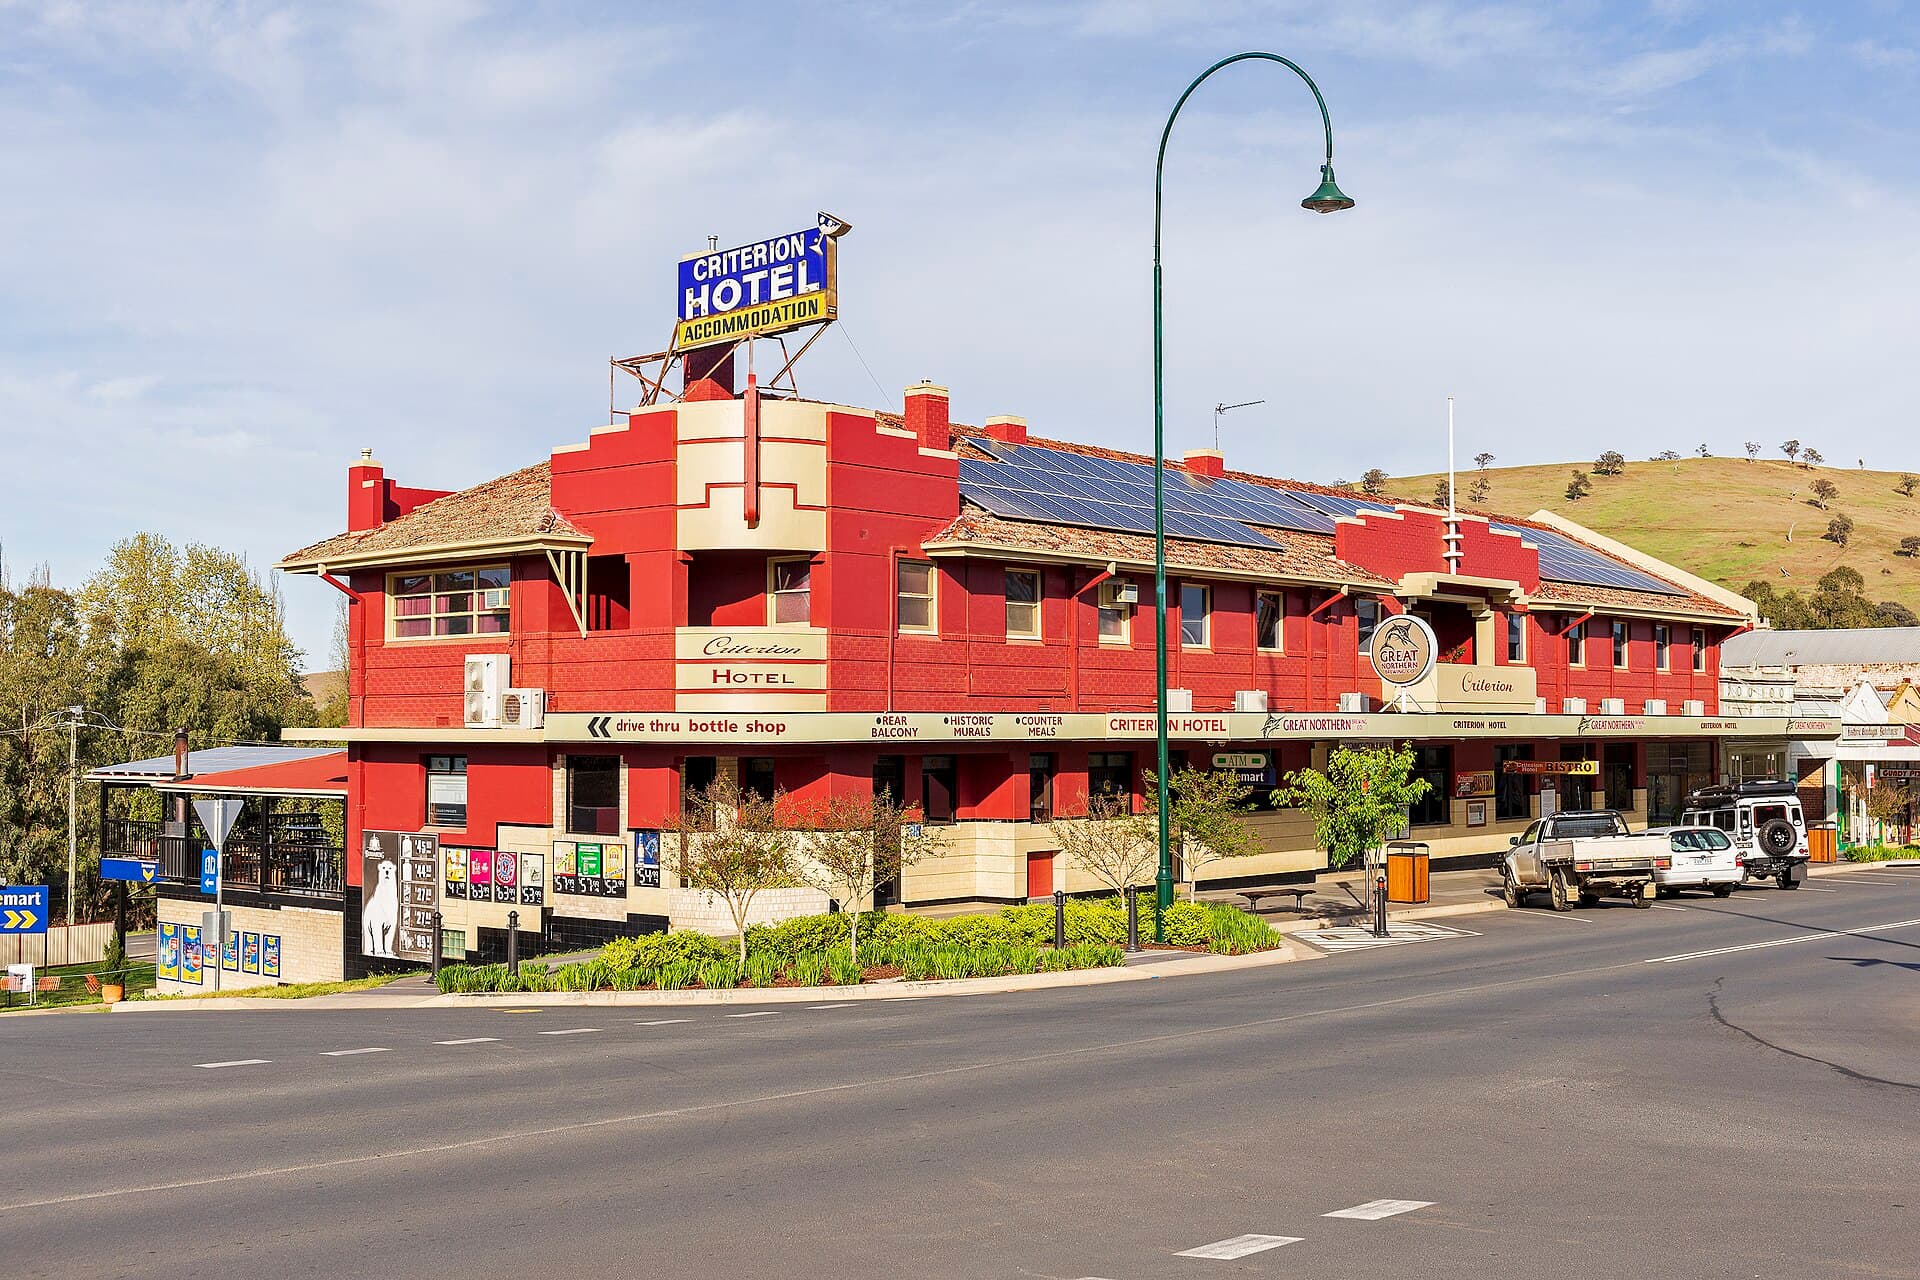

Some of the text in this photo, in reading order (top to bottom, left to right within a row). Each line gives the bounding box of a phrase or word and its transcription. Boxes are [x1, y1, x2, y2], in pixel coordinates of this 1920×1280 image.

[693, 233, 805, 281] CRITERION
[685, 260, 820, 320] HOTEL
[684, 298, 818, 343] ACCOMMODATION
[703, 636, 802, 656] Criterion
[1380, 650, 1419, 662] GREAT
[1381, 662, 1418, 670] NORTHERN
[1462, 671, 1514, 693] Criterion
[882, 716, 908, 726] REAR
[950, 716, 994, 726] HISTORIC
[1021, 716, 1063, 726] COUNTER
[1110, 719, 1227, 731] CRITERIN HOTEL
[1283, 719, 1351, 731] GREAT NORTHERN
[1453, 720, 1507, 729] CRITERION HOTEL
[1591, 720, 1607, 729] GREAT
[1607, 720, 1635, 729] NORTHERN
[616, 719, 786, 736] drive thru bottle shop
[871, 727, 918, 738] BALCONY
[953, 727, 991, 737] MURALS
[1028, 727, 1056, 737] MEALS
[1229, 755, 1247, 766] ATM
[1545, 762, 1592, 772] BISTRO
[1882, 769, 1907, 777] GUNDY
[1473, 774, 1494, 791] BISTRO
